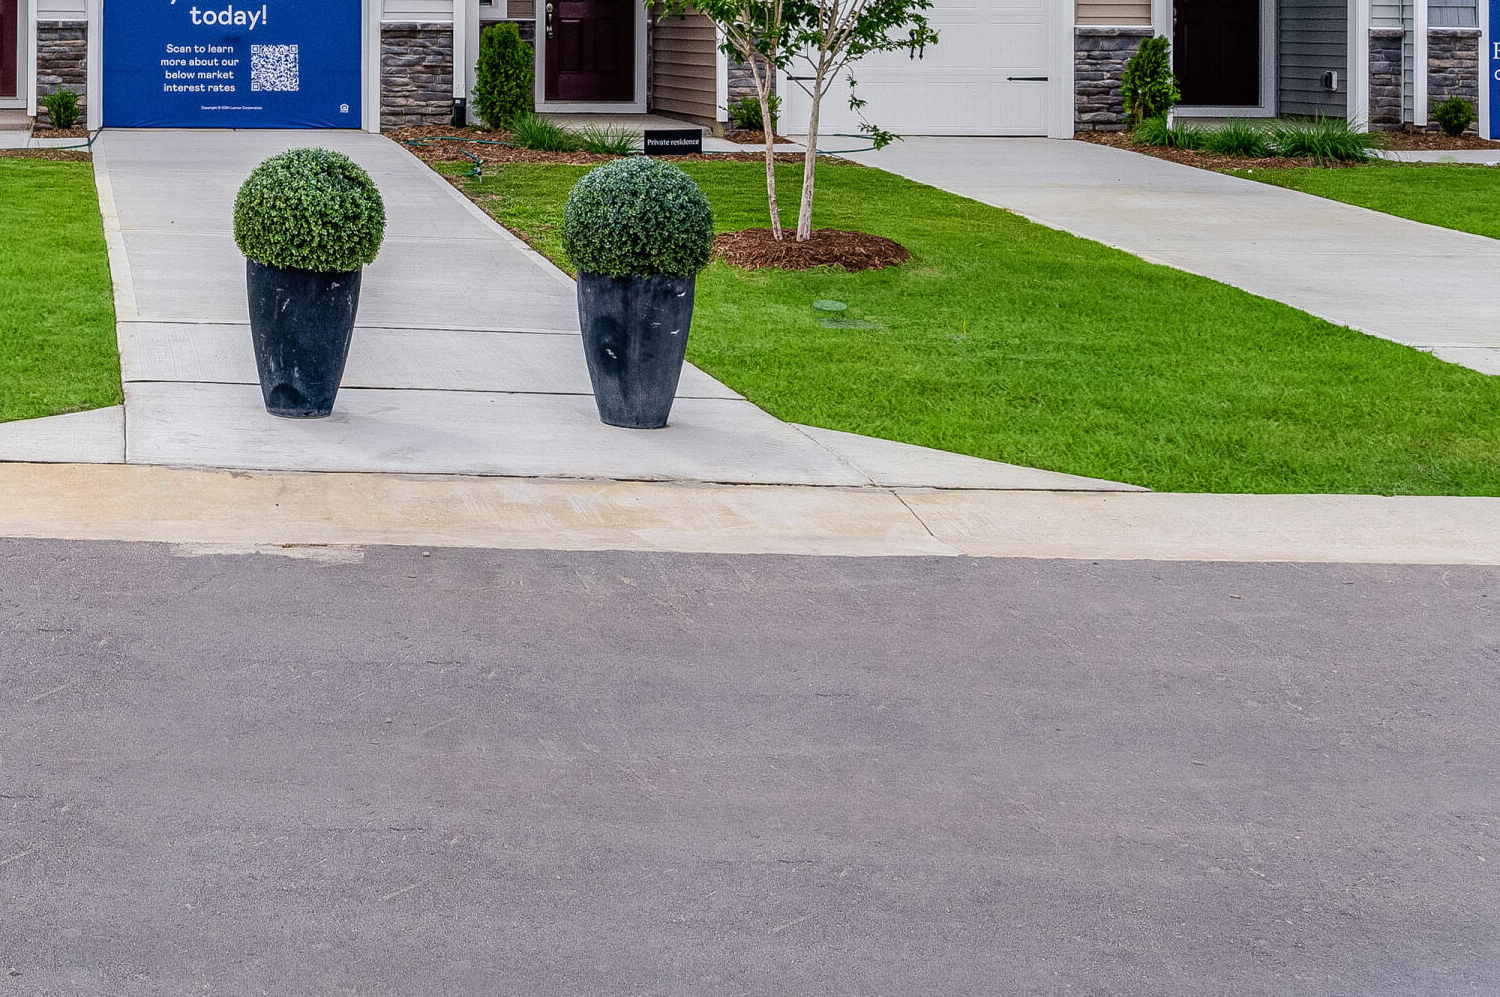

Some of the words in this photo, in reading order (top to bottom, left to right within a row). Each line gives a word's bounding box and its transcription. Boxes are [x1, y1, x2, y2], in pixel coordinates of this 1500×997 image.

[189, 4, 267, 30] today!
[166, 43, 192, 53] Scan
[194, 45, 206, 53] to
[208, 44, 234, 53] learn
[189, 57, 219, 66] about
[165, 70, 195, 79] below
[197, 70, 235, 79] market
[163, 83, 206, 92] interest
[208, 83, 236, 92] rates
[647, 138, 670, 146] Private
[671, 138, 700, 146] residence
